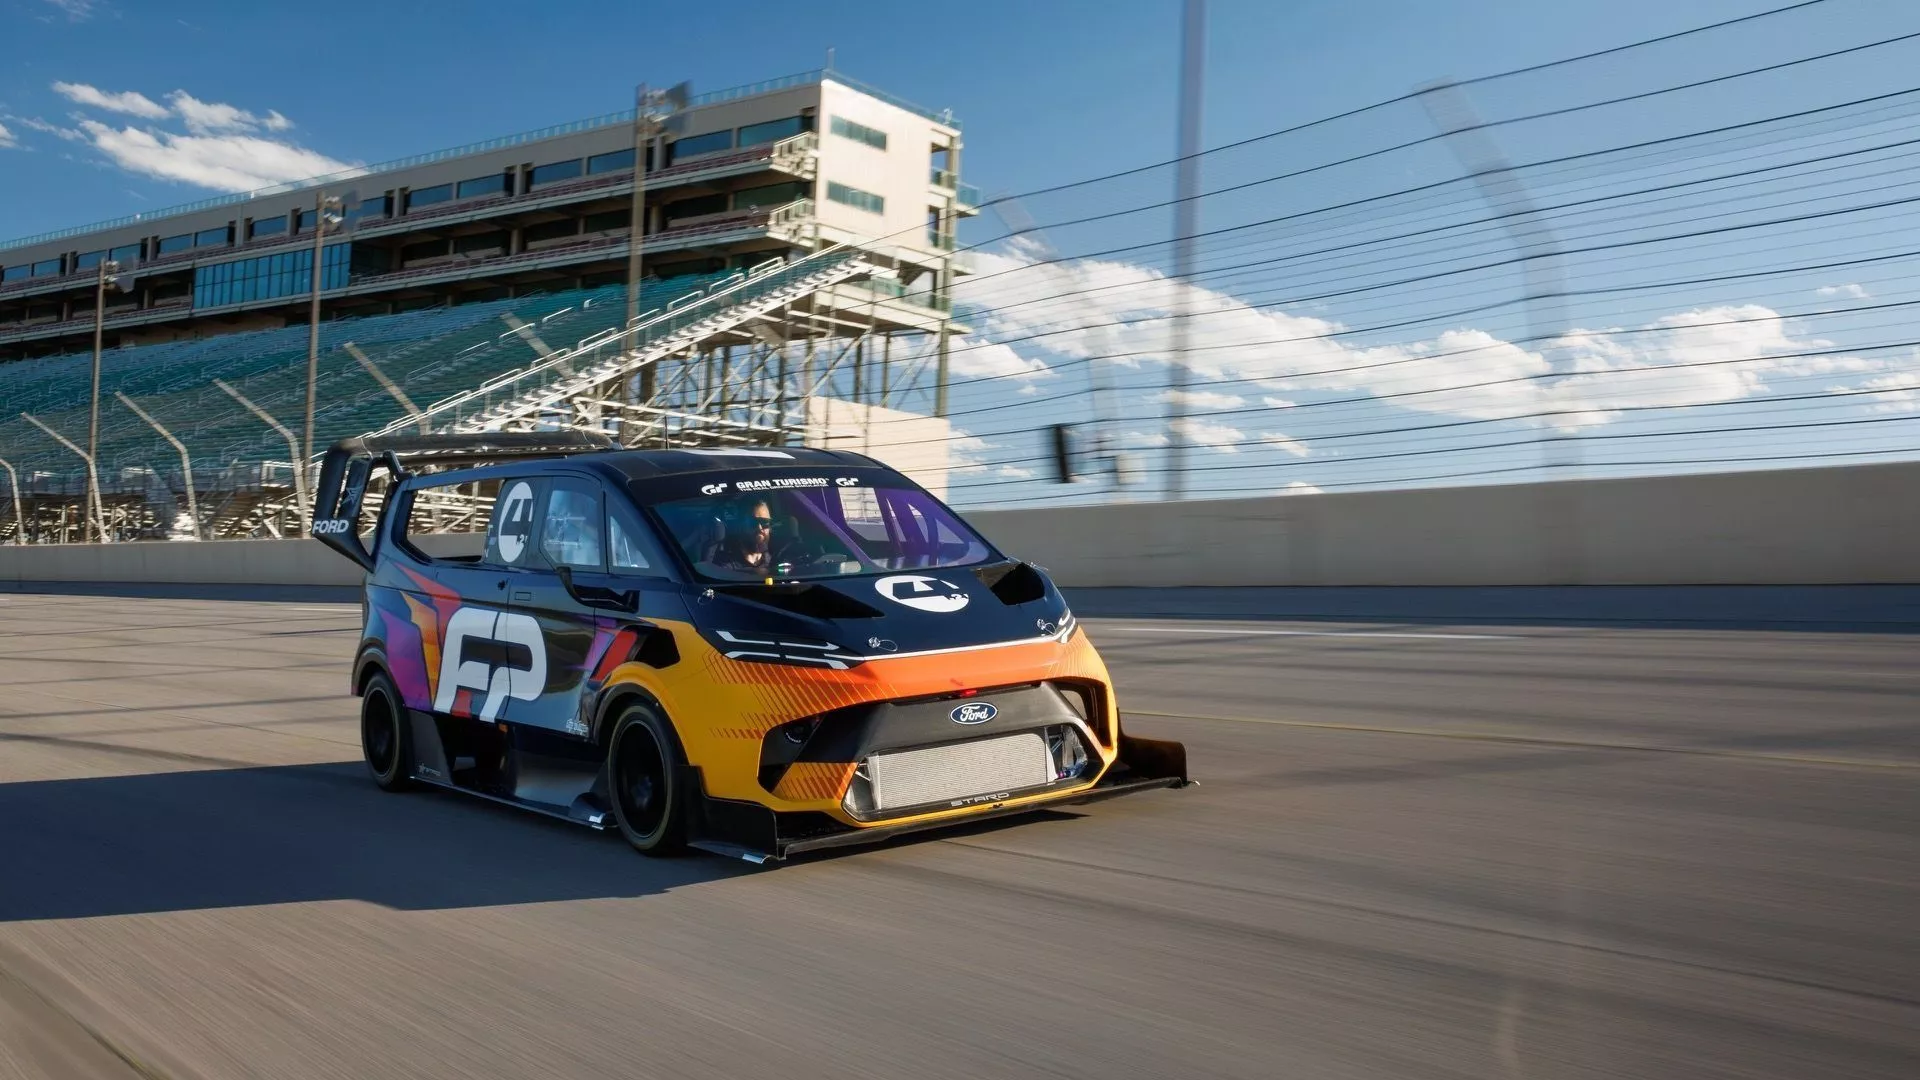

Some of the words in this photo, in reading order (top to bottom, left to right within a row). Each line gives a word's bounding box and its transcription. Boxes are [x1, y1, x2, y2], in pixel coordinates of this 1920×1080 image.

[735, 480, 771, 489] GRAN
[312, 519, 349, 534] FORD
[960, 705, 989, 721] Ford
[950, 792, 1010, 807] STARD
